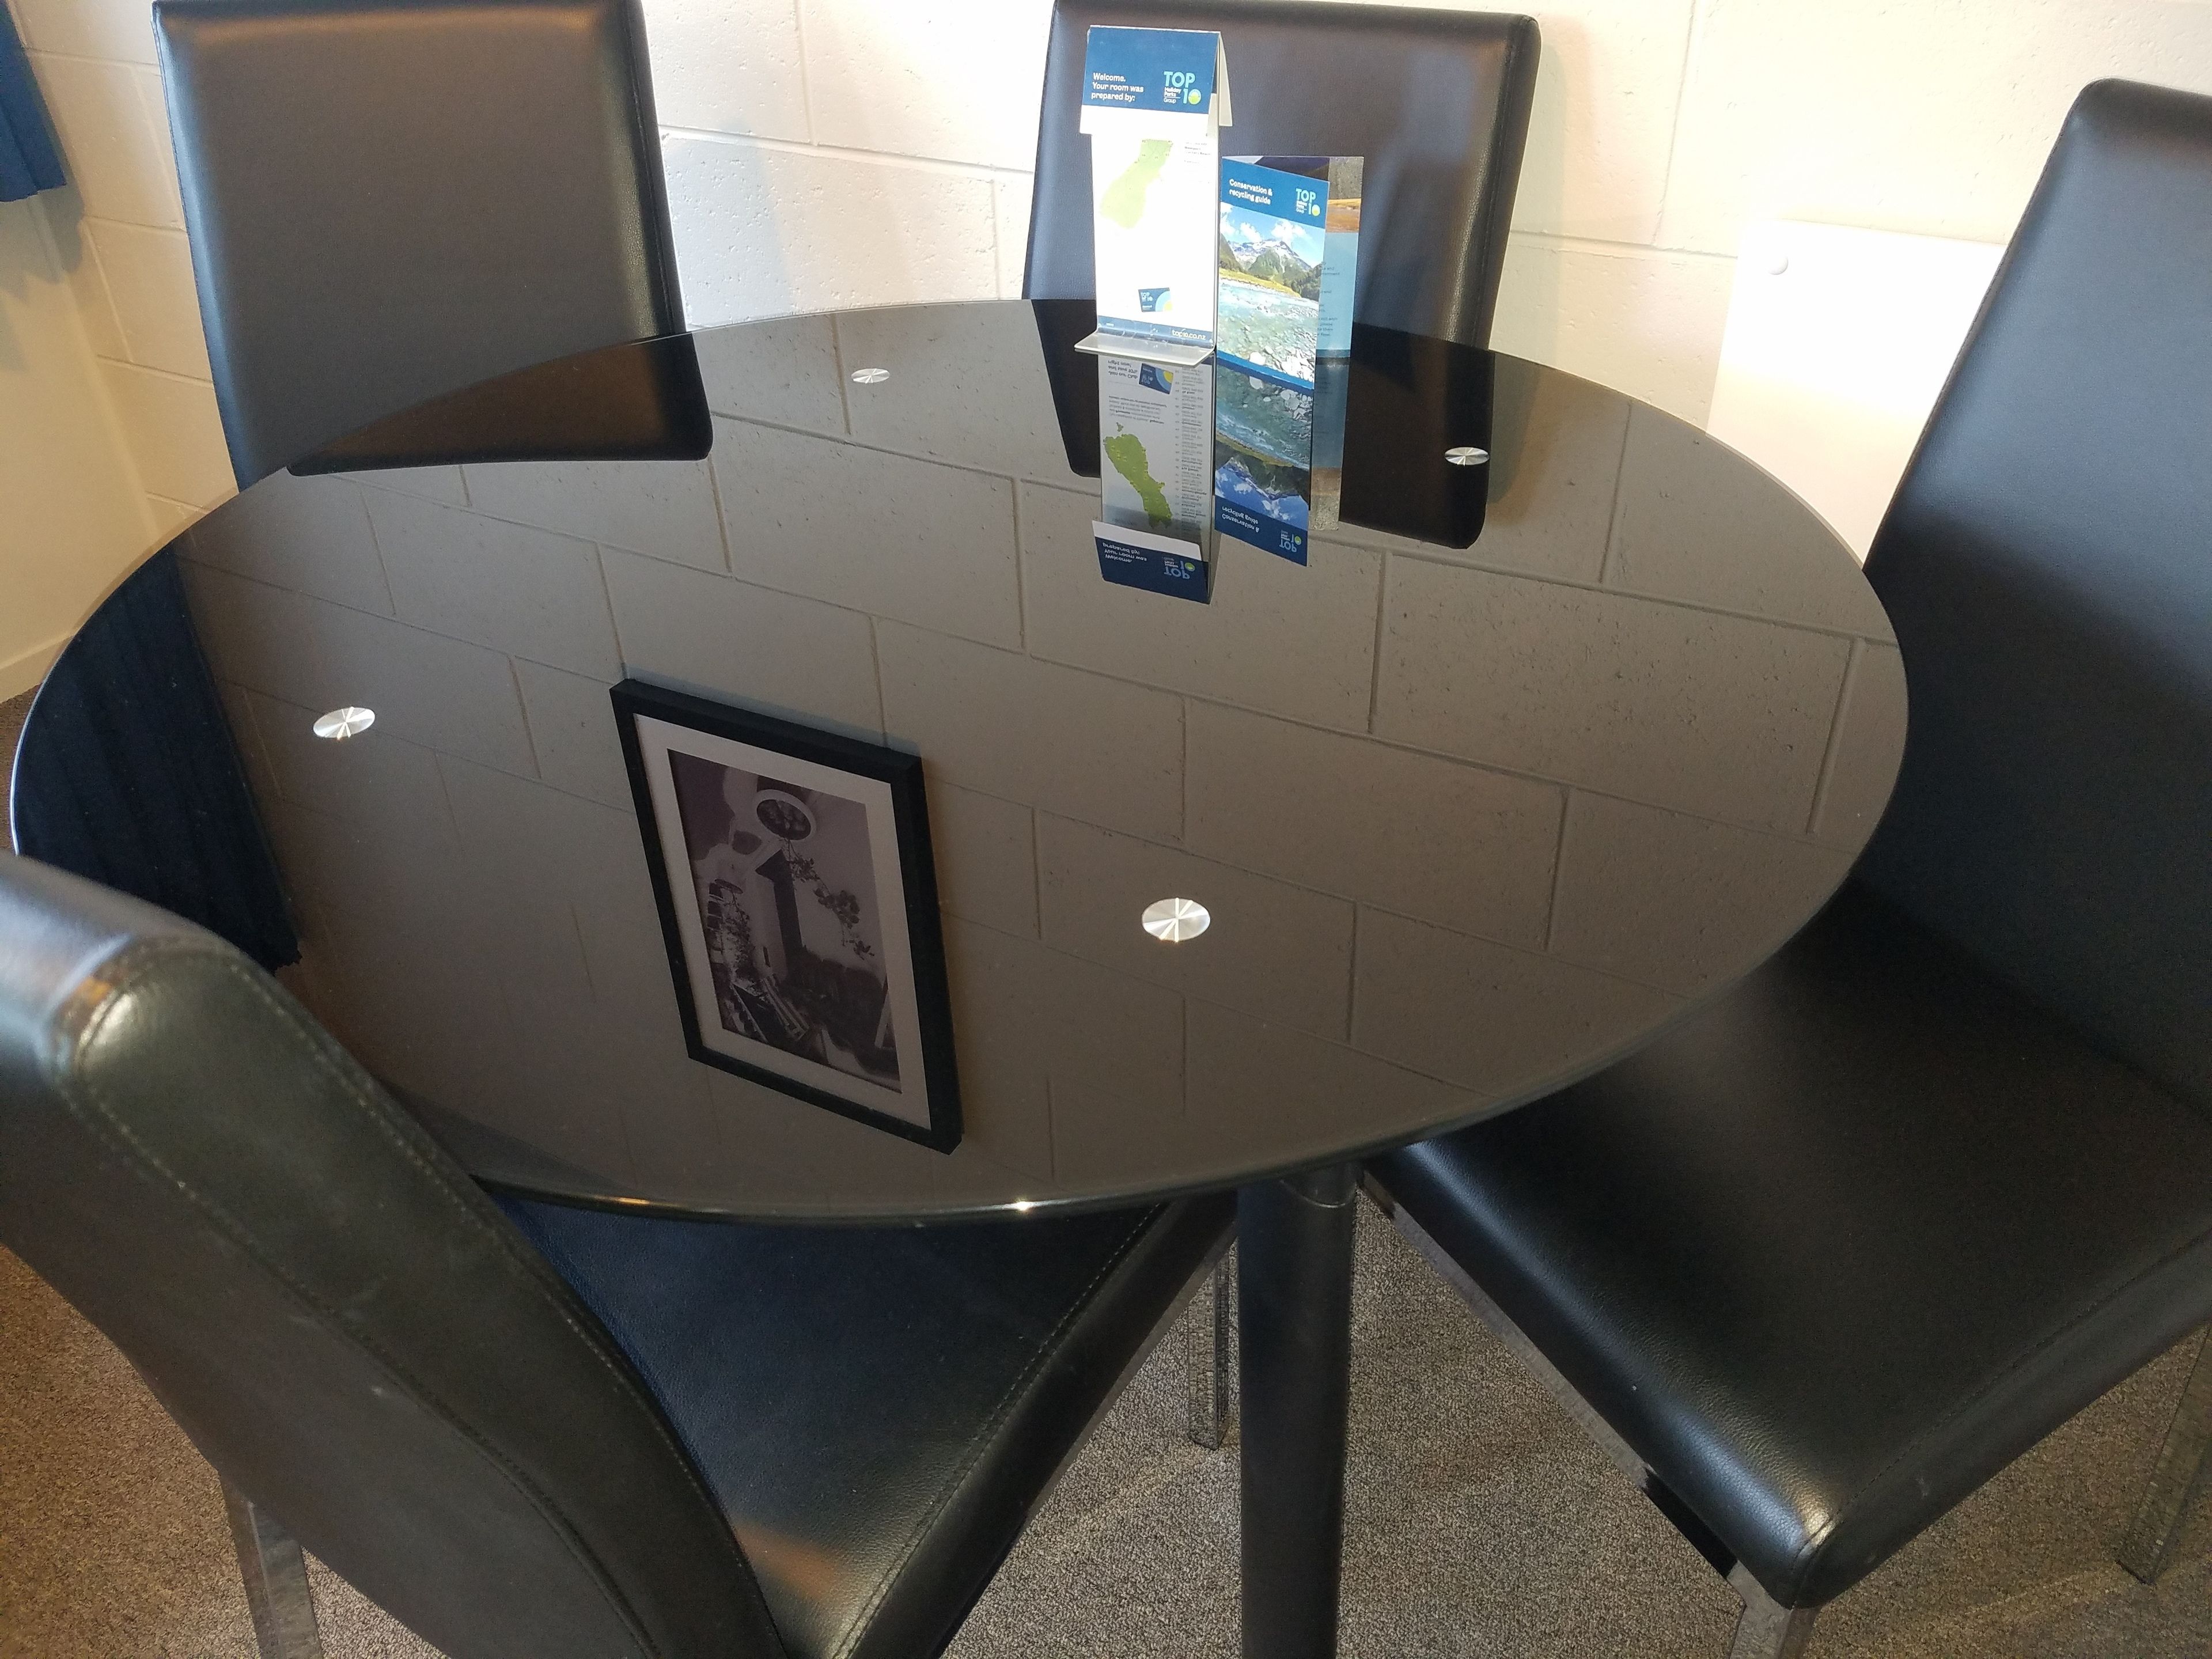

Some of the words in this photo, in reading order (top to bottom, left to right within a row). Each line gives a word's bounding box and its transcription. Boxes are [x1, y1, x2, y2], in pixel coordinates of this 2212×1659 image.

[1093, 73, 1126, 82] Welcome.
[1164, 71, 1195, 88] TOP
[1092, 82, 1108, 90] Your
[1091, 92, 1123, 101] prepared
[1124, 93, 1135, 102] by:
[1183, 88, 1202, 105] 10
[1229, 179, 1267, 195] Conservation
[1267, 188, 1273, 196] &
[1229, 188, 1255, 202] recycling
[1255, 195, 1271, 205] guide
[1296, 188, 1316, 203] TOP
[1308, 203, 1321, 217] 10
